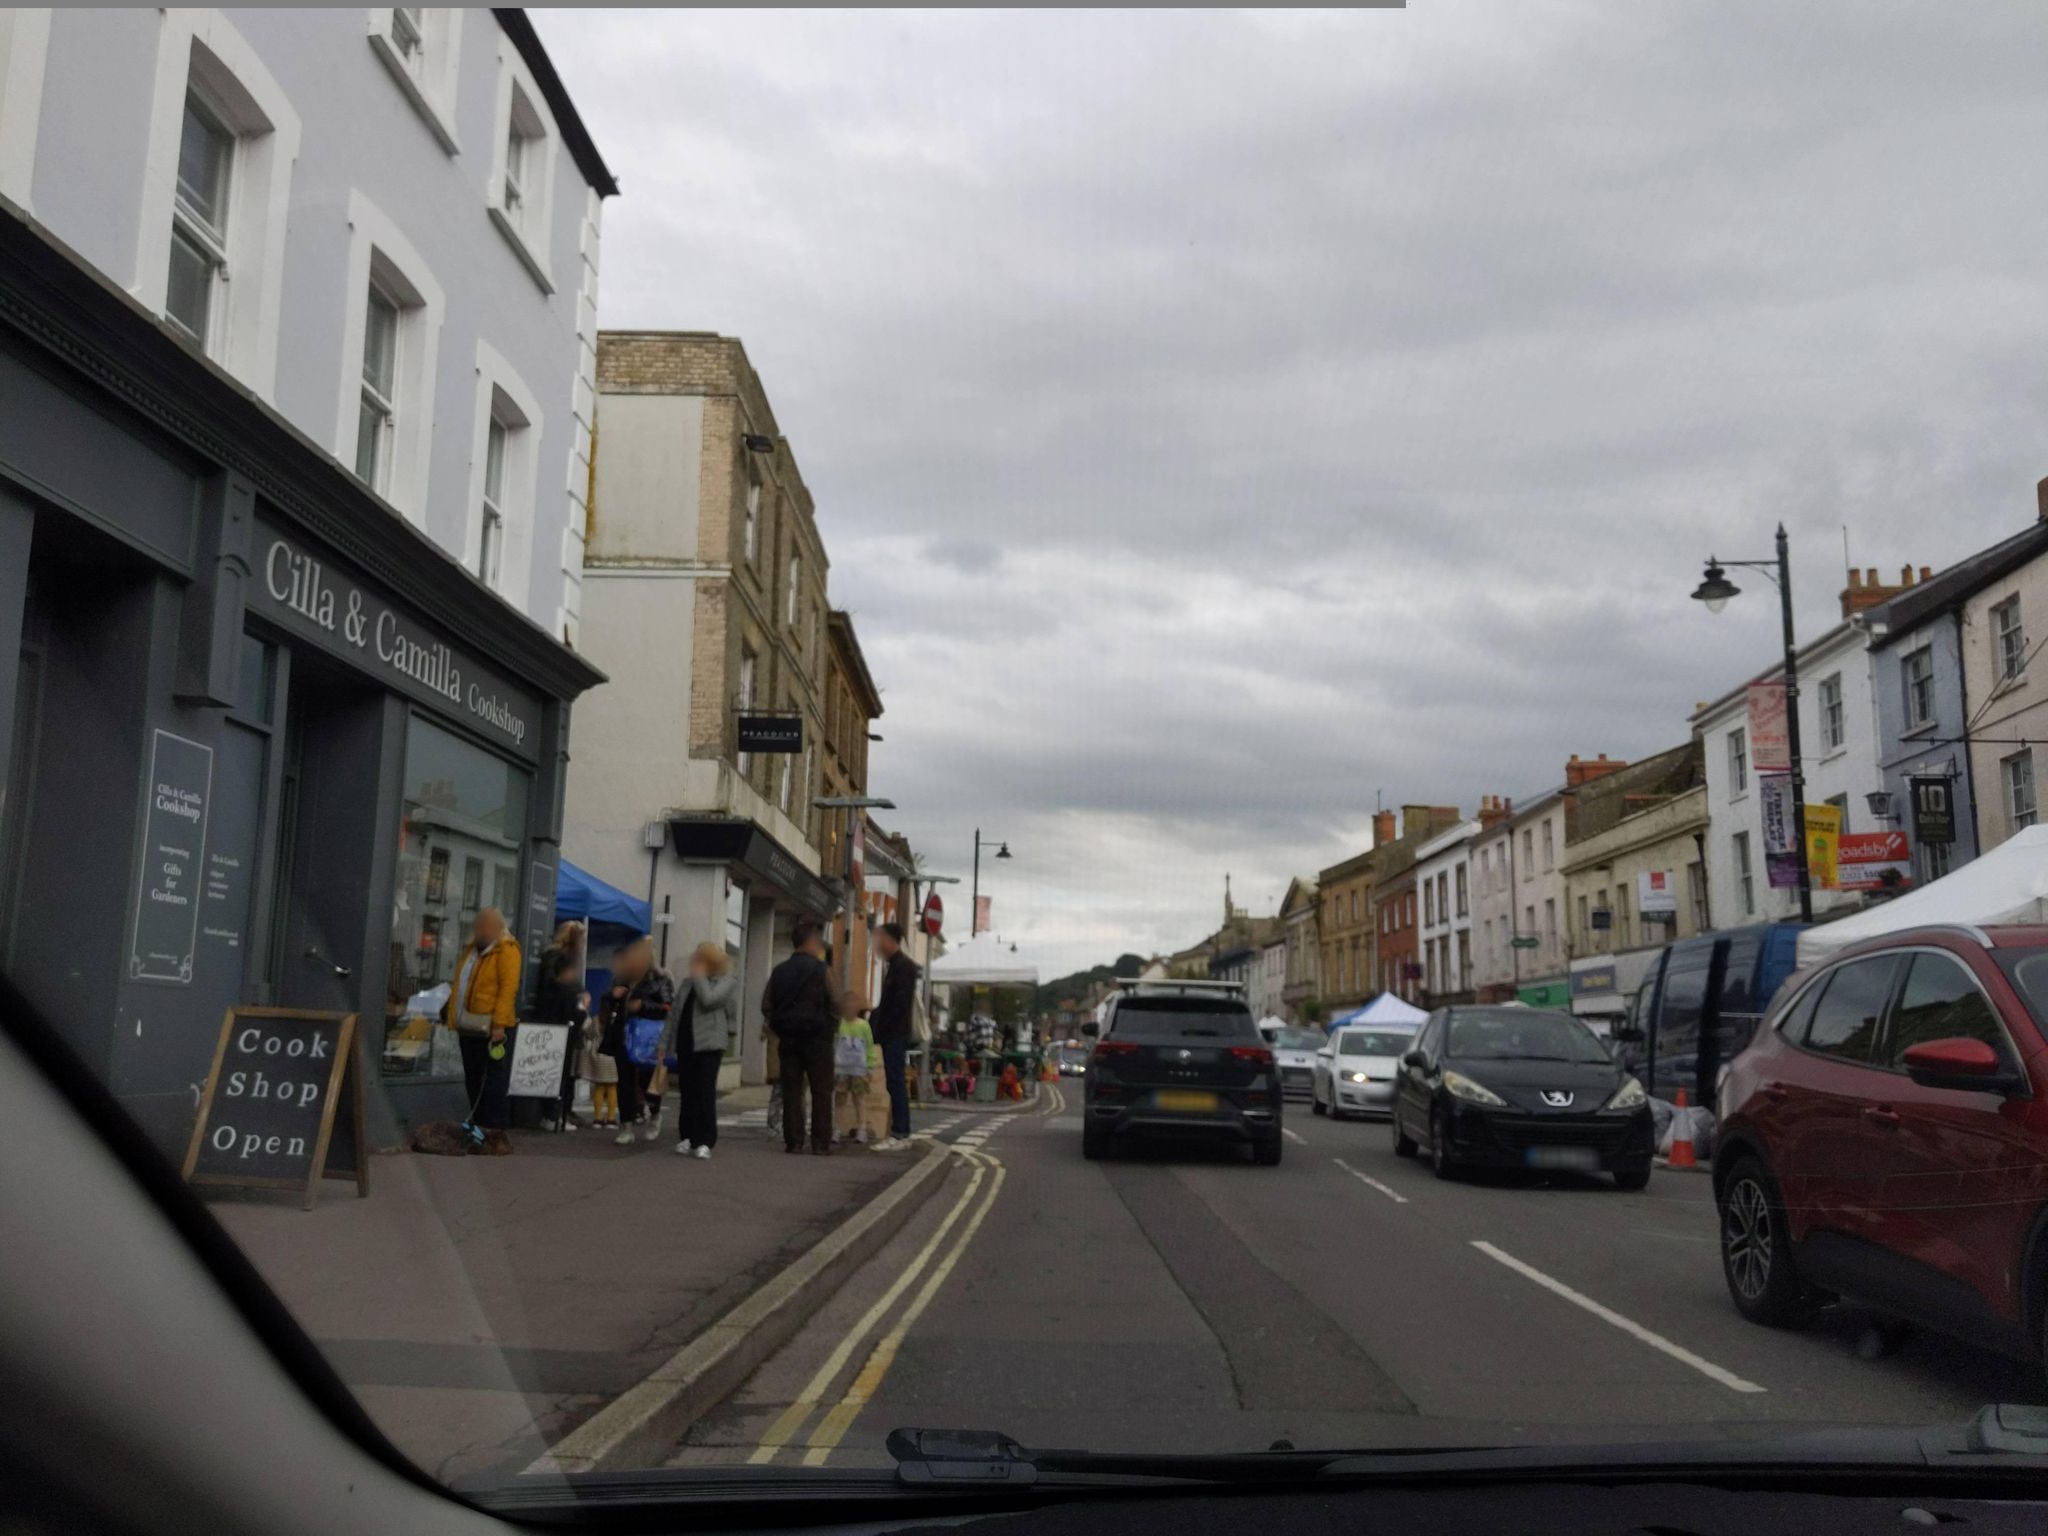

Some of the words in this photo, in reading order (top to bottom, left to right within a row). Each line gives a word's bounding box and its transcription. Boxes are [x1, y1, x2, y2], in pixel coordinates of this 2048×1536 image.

[266, 540, 335, 631] Cilla
[344, 588, 368, 648] &
[376, 609, 462, 703] Camilla
[468, 683, 526, 746] Cookshop
[157, 795, 201, 824] Cookshop
[163, 862, 182, 876] Gifts
[238, 1029, 328, 1058] Cook
[226, 1072, 318, 1107] Shop
[212, 1125, 305, 1158] Open
